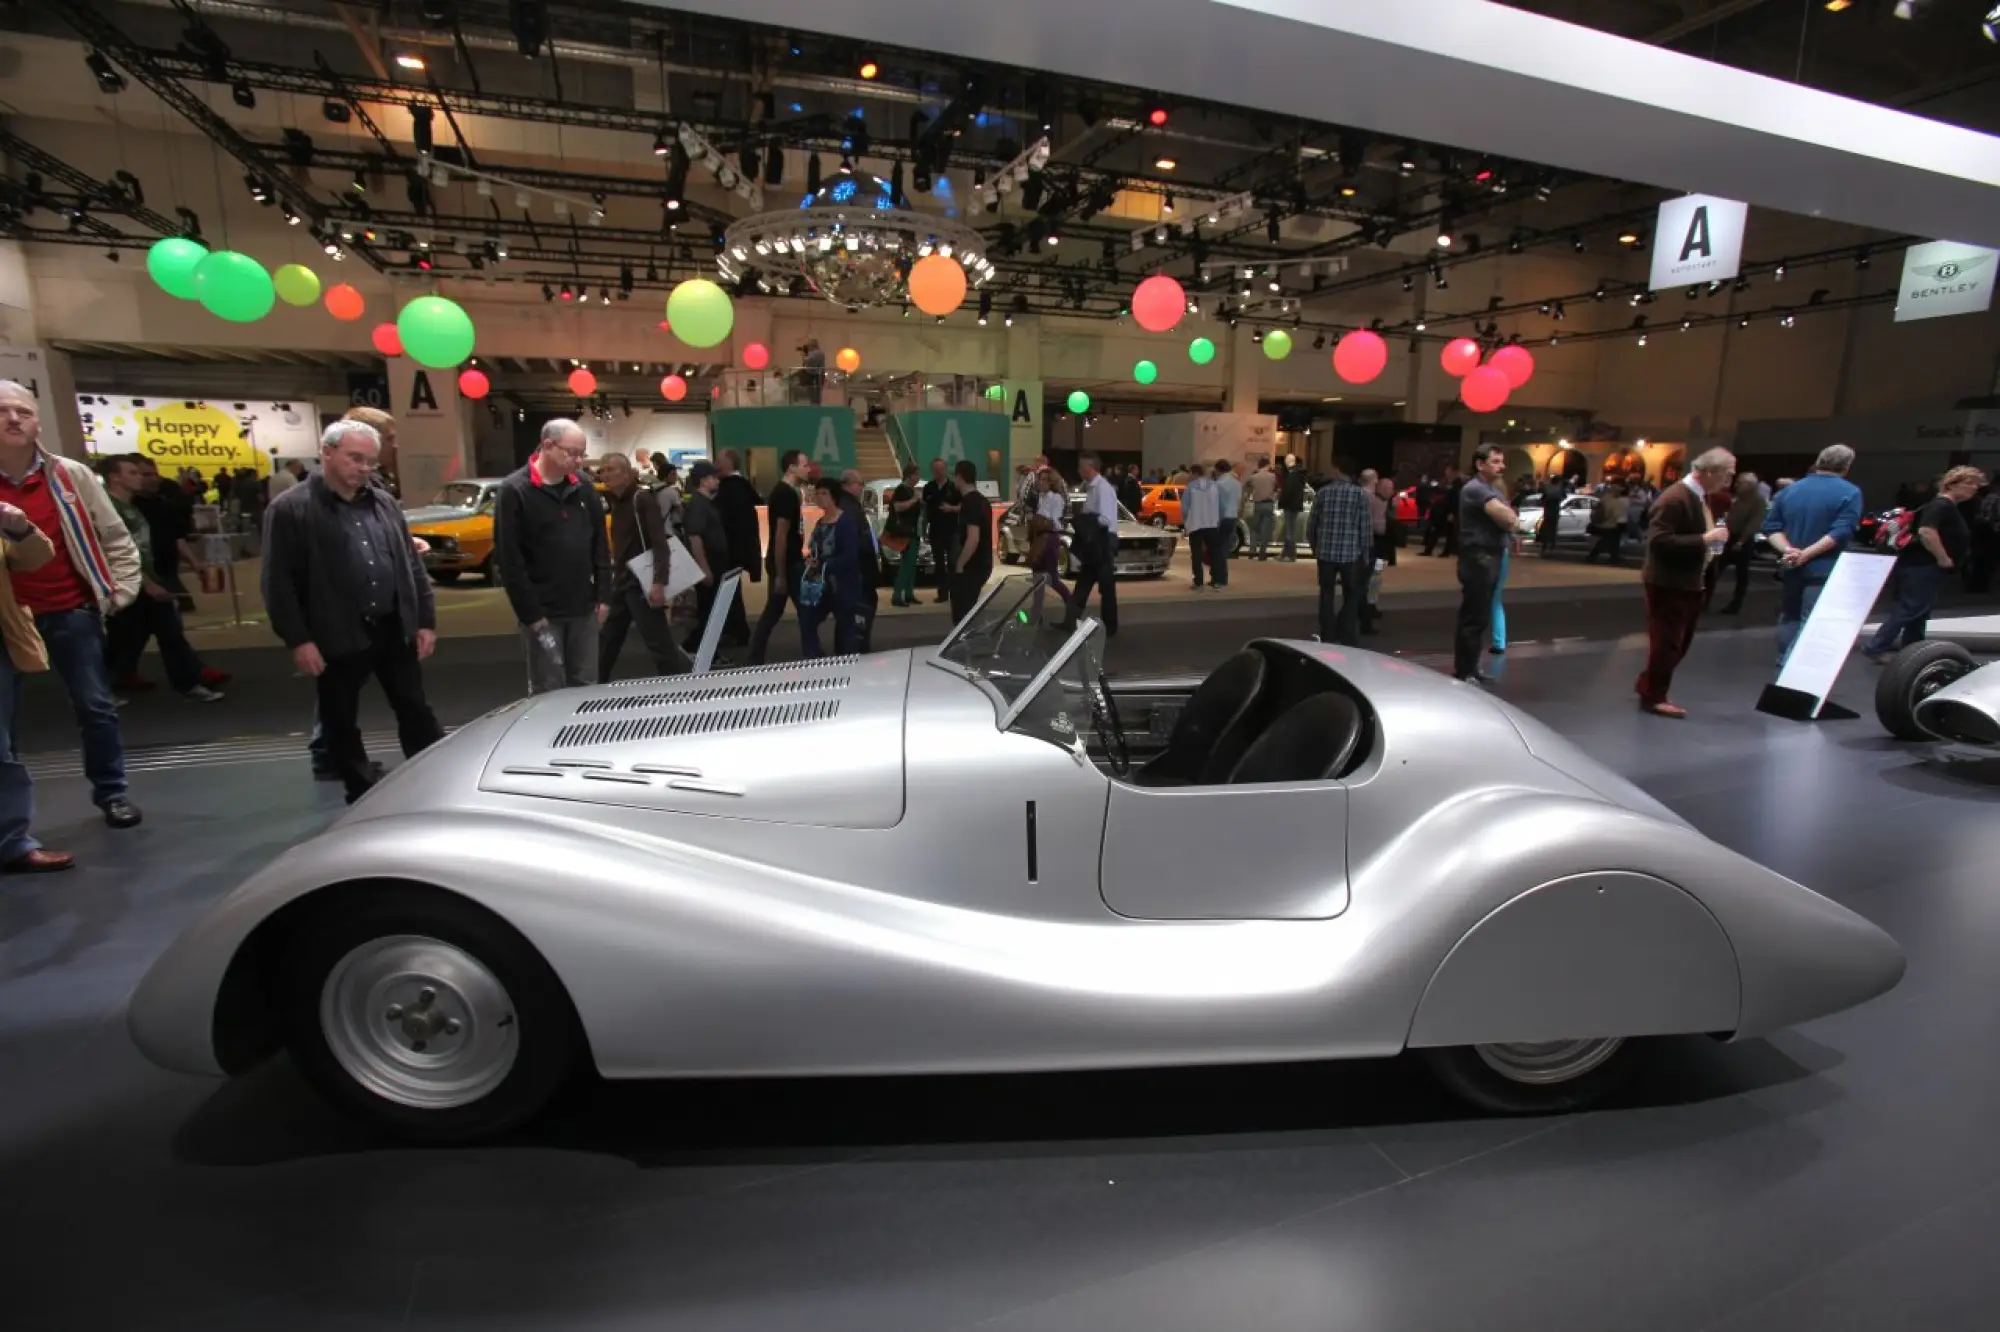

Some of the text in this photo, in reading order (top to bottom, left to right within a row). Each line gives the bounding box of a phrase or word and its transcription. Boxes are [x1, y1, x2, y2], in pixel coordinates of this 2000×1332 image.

[1678, 204, 1712, 262] A
[1911, 281, 1979, 299] BENTLEY
[410, 369, 438, 410] A
[1012, 389, 1031, 422] A
[144, 416, 221, 437] Happy
[812, 416, 841, 462] A
[940, 418, 965, 462] A
[147, 438, 241, 460] Golfday.
